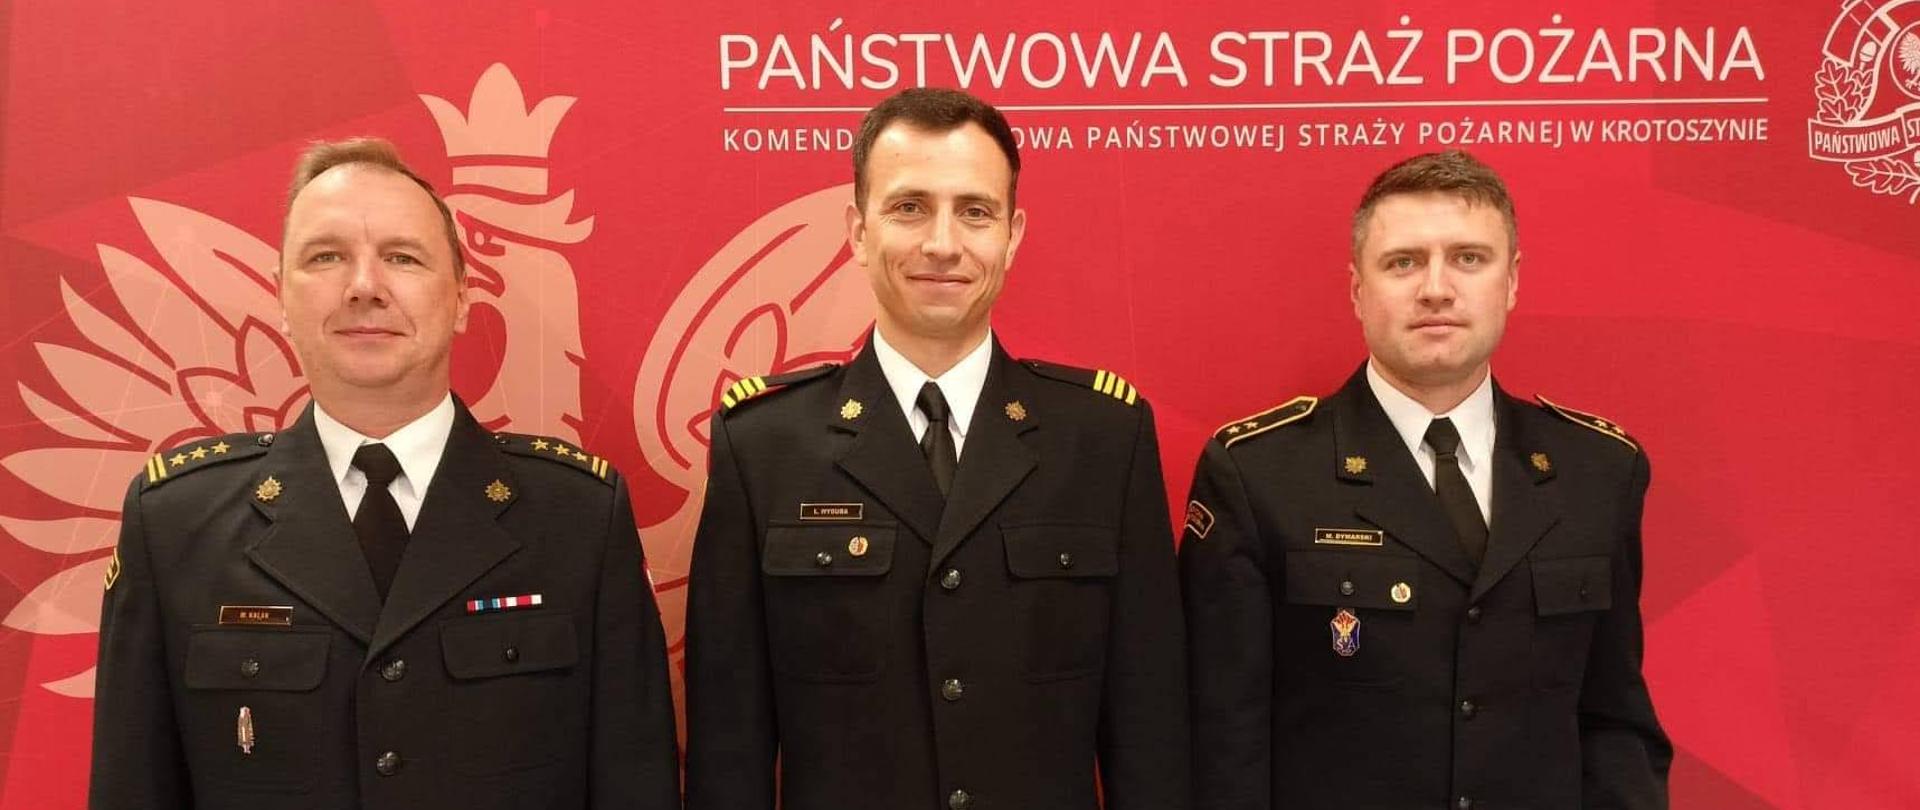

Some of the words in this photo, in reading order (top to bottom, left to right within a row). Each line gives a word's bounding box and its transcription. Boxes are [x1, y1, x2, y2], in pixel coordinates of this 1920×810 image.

[719, 17, 1188, 90] PAŃSTWOWA
[1209, 14, 1424, 87] STRAŻ
[1447, 13, 1765, 85] POŻARNA
[723, 128, 854, 152] KOMEND
[1087, 120, 1285, 152] PAŃSTWOWEJ
[1299, 117, 1406, 147] STRAŻY
[1418, 116, 1563, 148] POŻARNEJ
[1570, 120, 1595, 143] W
[1601, 118, 1769, 142] KROTOSZYNIE
[1814, 125, 1901, 154] PAŃSTWOWA
